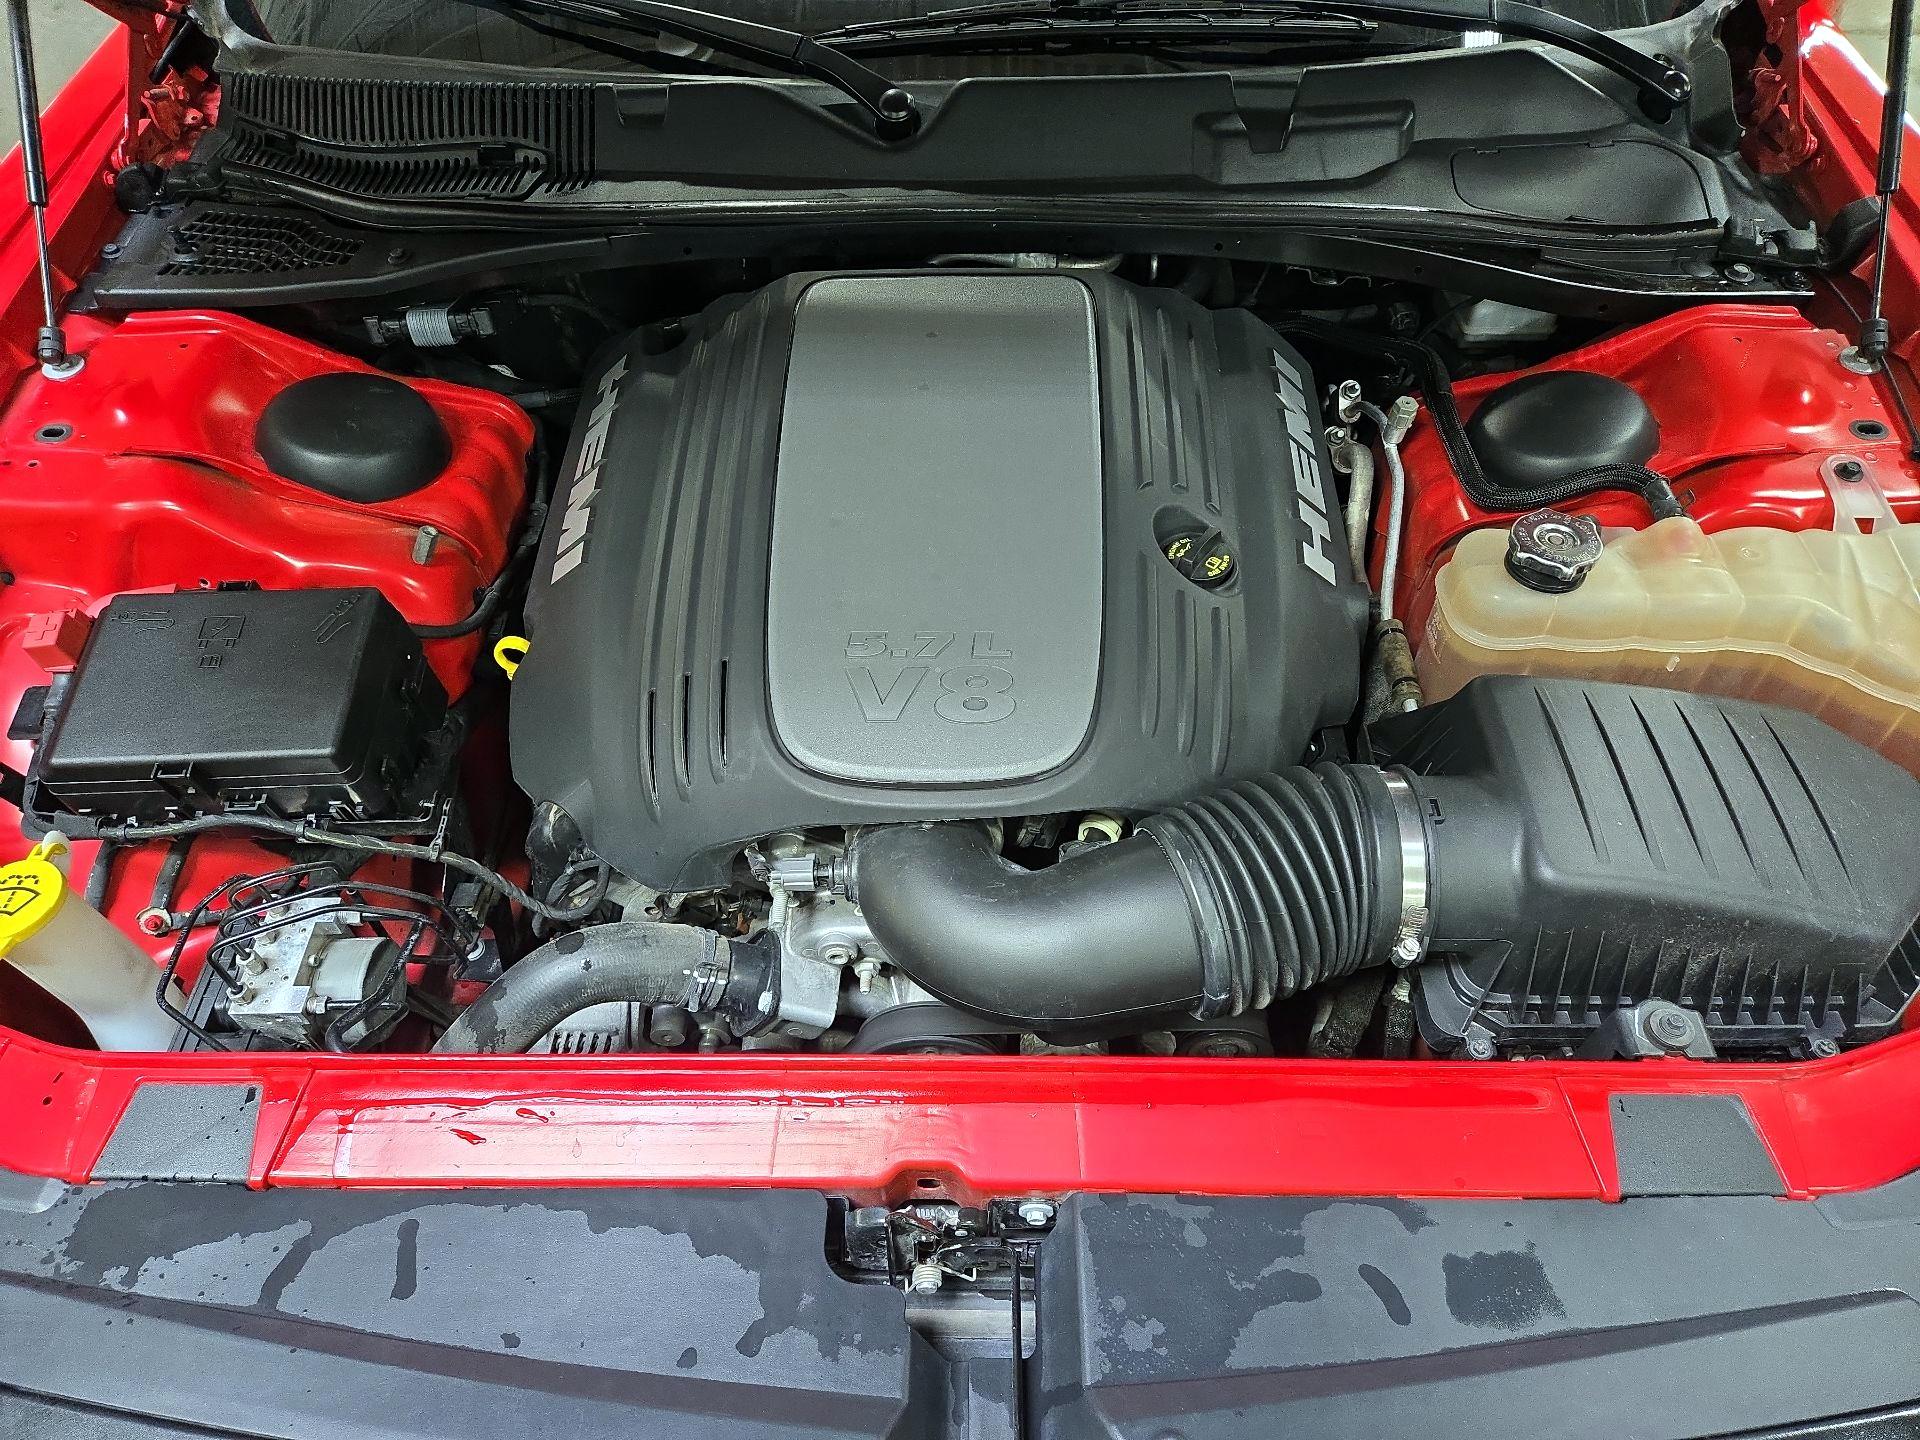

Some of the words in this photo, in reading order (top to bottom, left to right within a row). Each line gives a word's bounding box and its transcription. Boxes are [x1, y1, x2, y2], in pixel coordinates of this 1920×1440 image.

[550, 353, 630, 585] HEMI
[1272, 348, 1337, 587] HEMI
[843, 664, 1018, 725] V8
